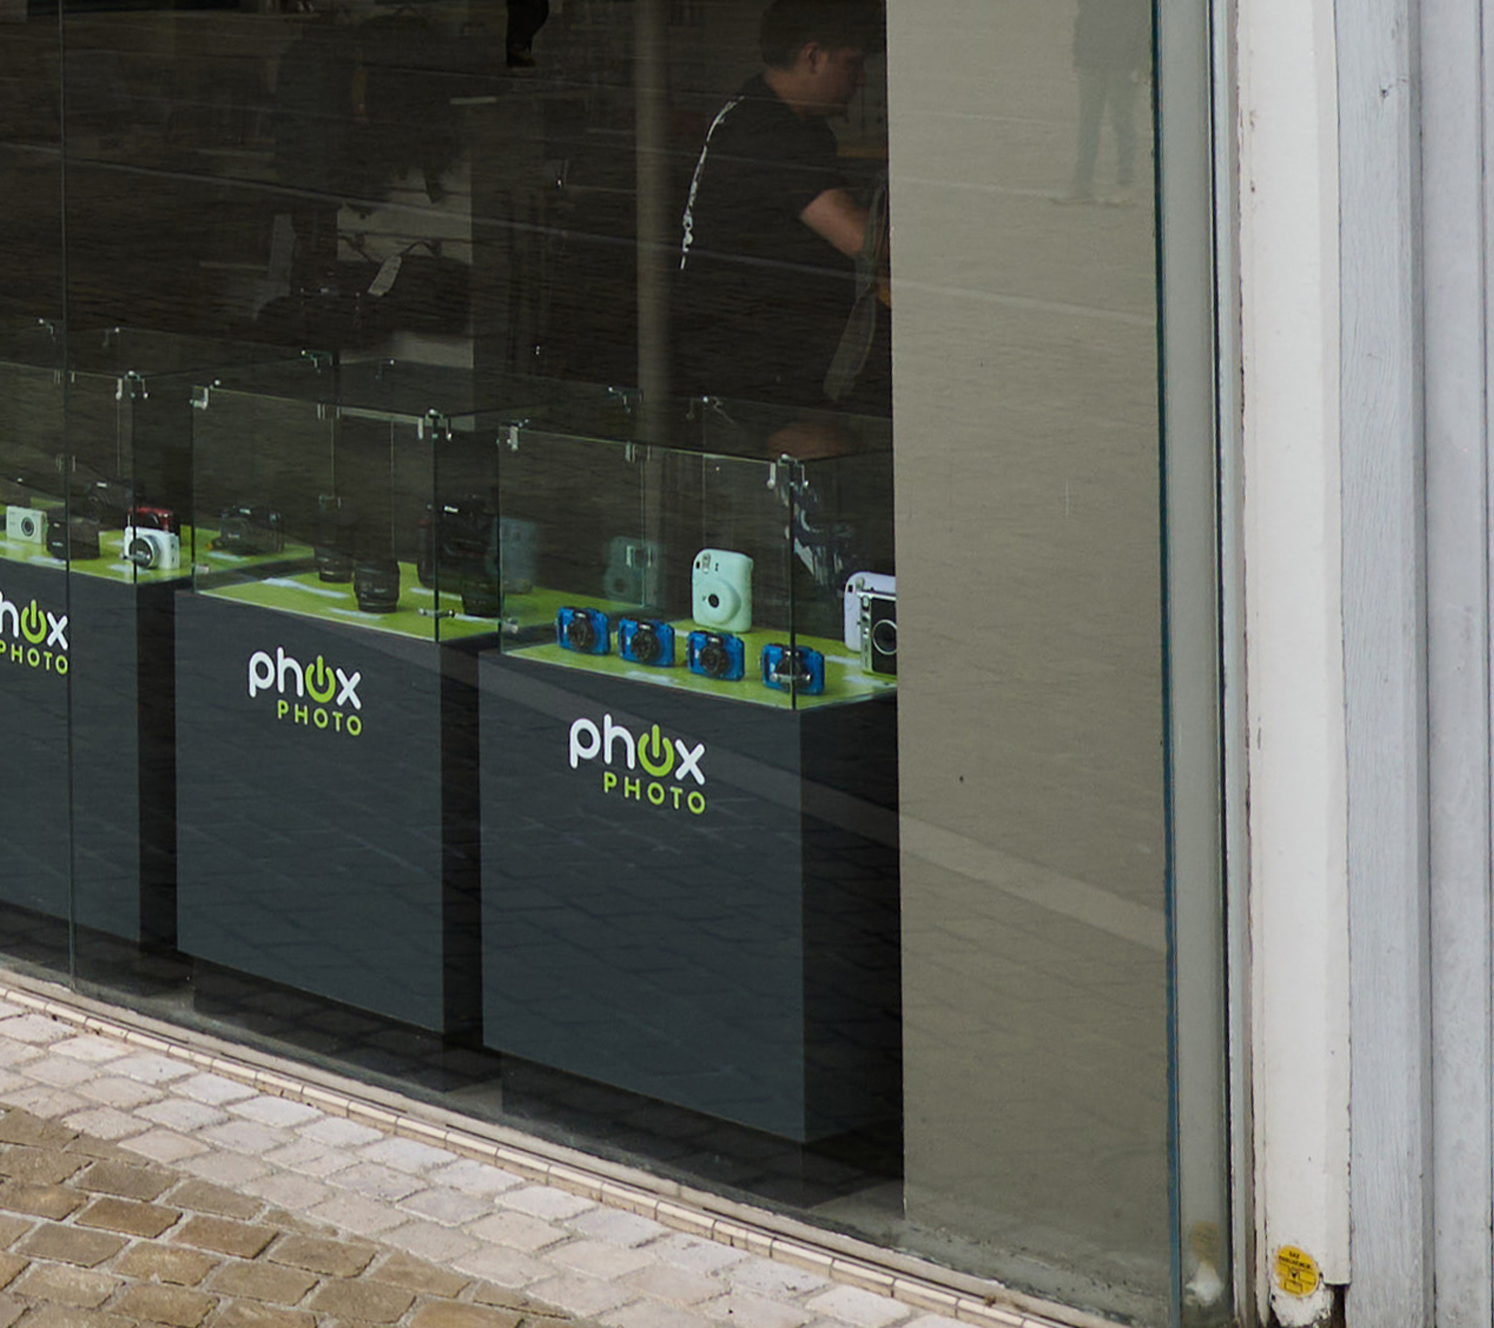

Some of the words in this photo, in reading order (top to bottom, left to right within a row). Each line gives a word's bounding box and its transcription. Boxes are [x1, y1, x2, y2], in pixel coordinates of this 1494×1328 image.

[248, 646, 362, 711] phox
[276, 698, 362, 737] PHOTO
[568, 713, 705, 787] phox
[603, 771, 706, 815] PHOTO
